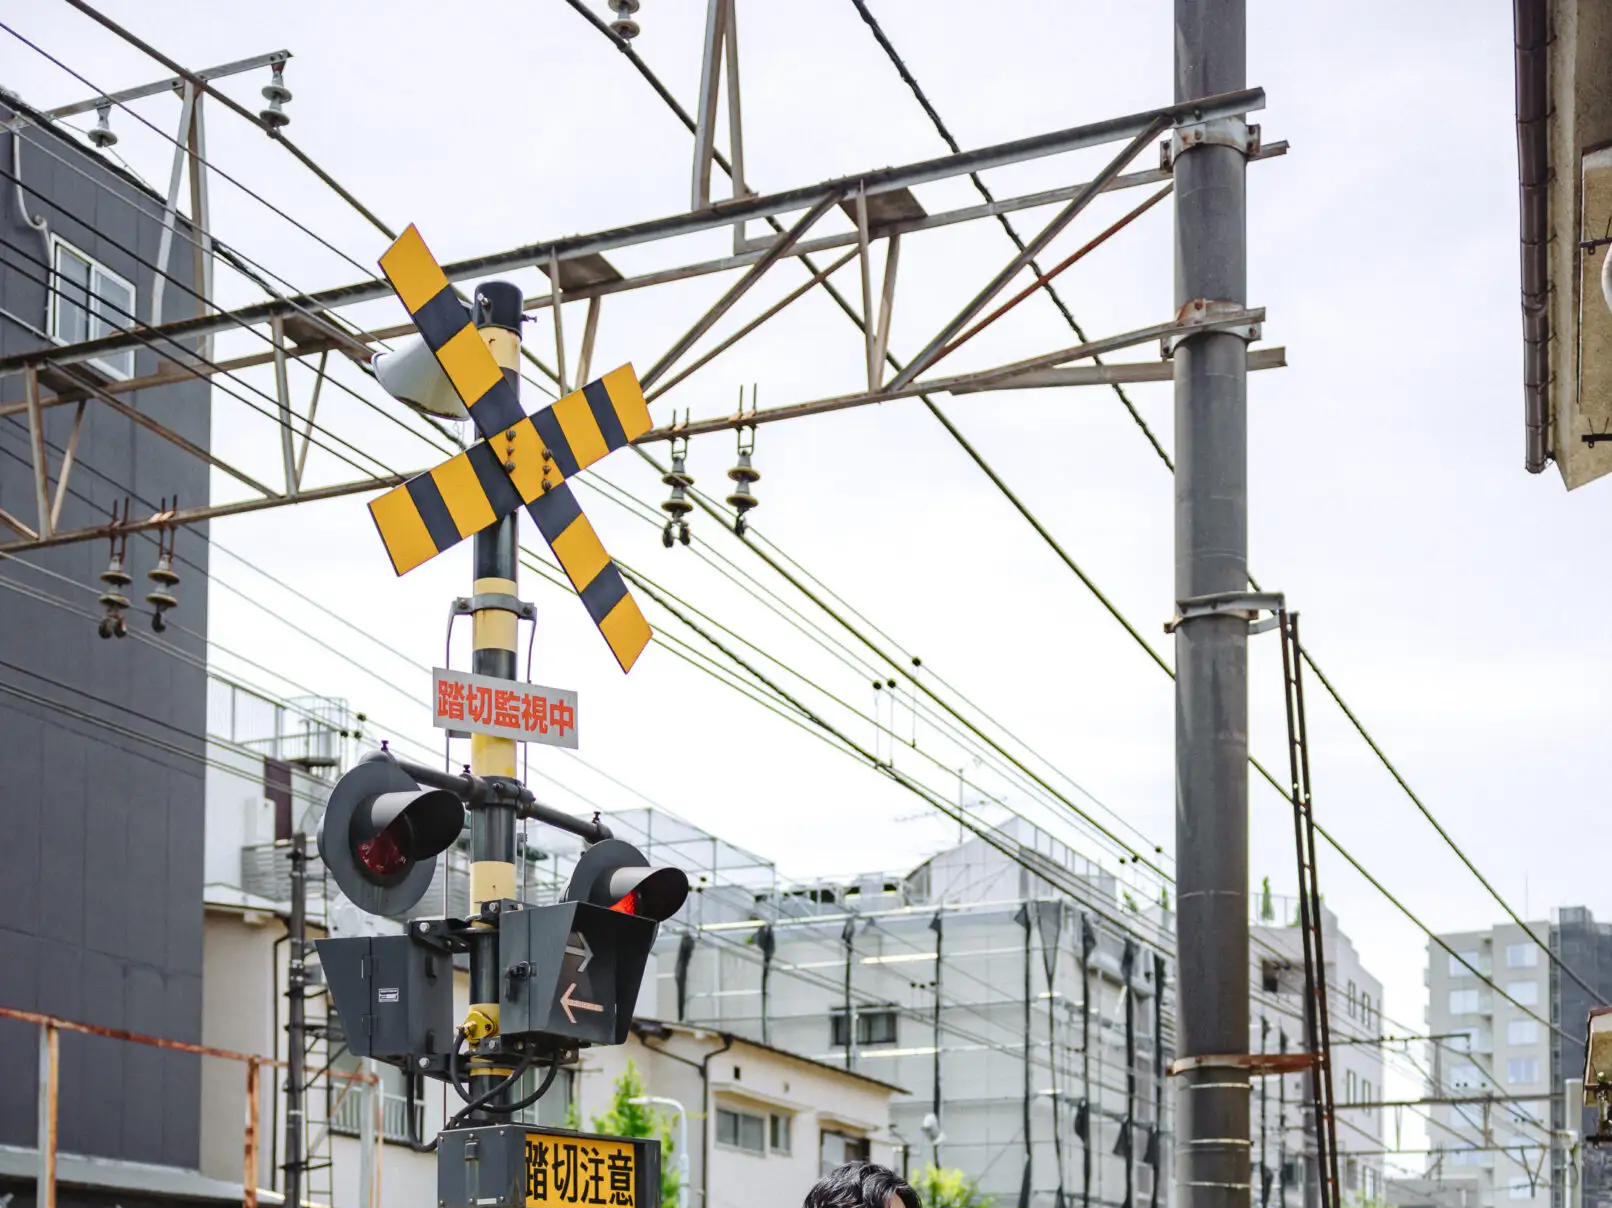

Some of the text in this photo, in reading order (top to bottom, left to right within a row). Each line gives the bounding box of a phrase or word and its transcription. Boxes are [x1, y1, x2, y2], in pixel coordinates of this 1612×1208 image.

[437, 679, 575, 737] 踏切監視中
[525, 1140, 634, 1207] 踏切注意
